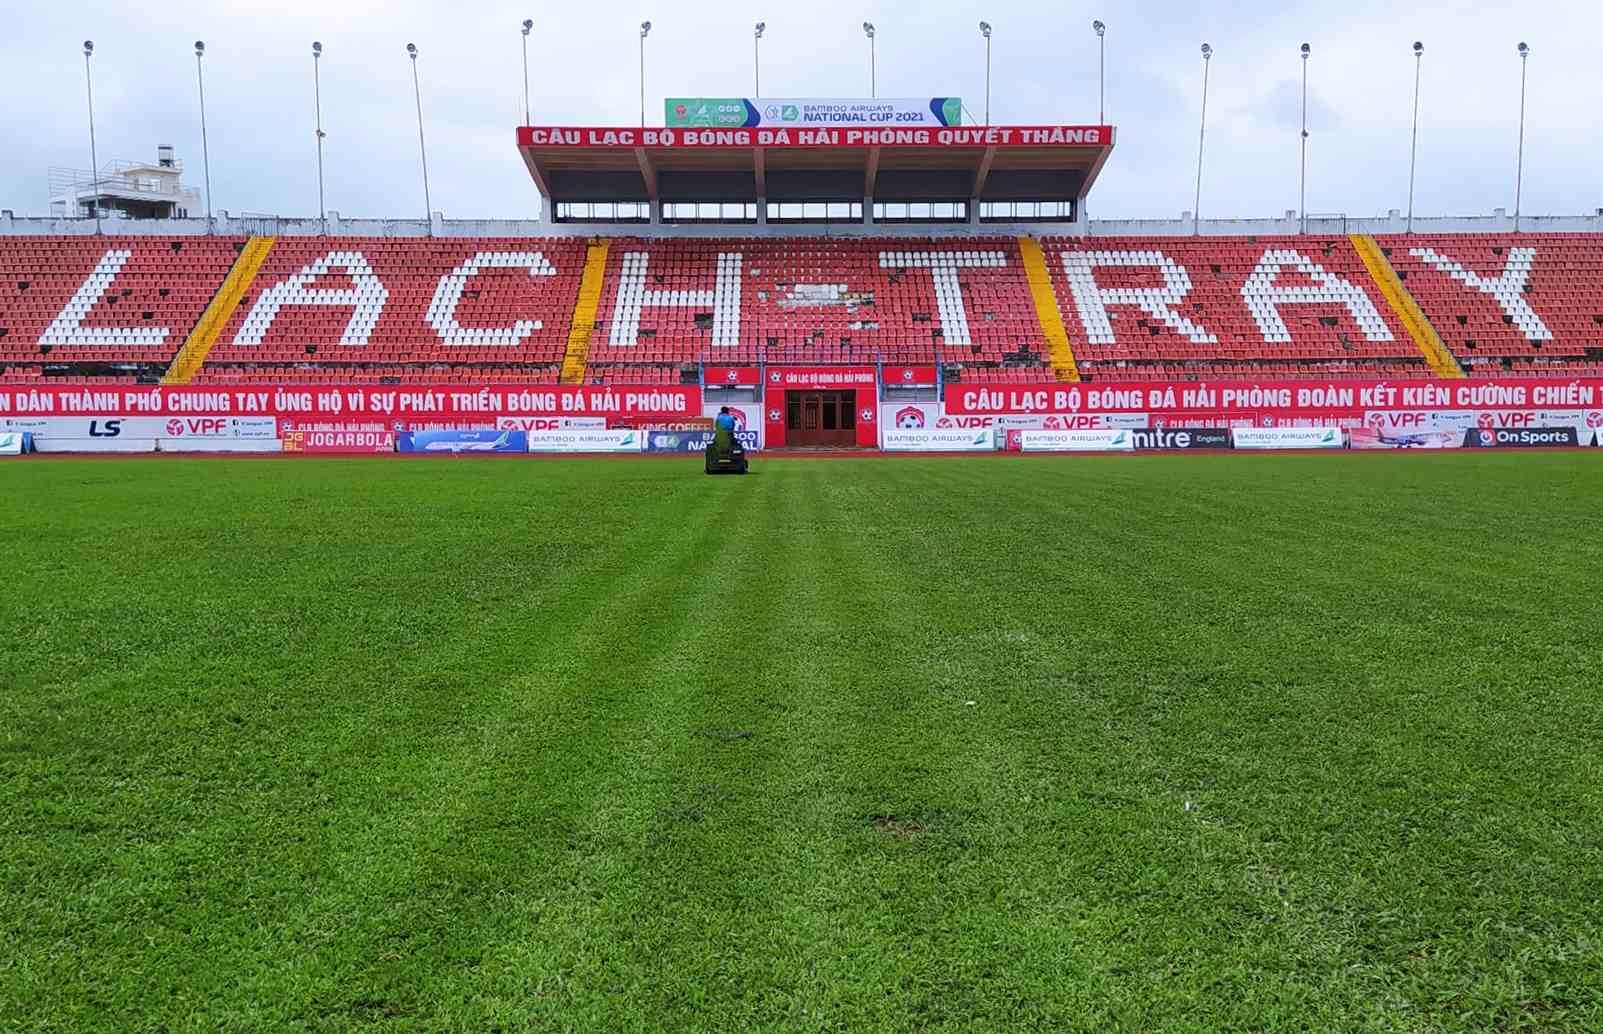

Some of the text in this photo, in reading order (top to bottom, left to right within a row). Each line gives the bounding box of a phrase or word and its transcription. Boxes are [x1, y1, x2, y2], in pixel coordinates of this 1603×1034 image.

[804, 105, 894, 113] BAMBOO AIRWAYS
[803, 112, 924, 122] NATIONAL CUP 2021
[532, 125, 1100, 147] CÂU LẠC BỘ BÓNG ĐÁ HẢI PHÒNG QUYẾT THẮNG
[16, 389, 53, 411] DÂN
[59, 389, 118, 411] THÀNH
[125, 388, 162, 411] PHỐ
[168, 393, 230, 411] CHUNG
[236, 393, 269, 411] TAY
[275, 388, 312, 411] ỦNG
[318, 389, 341, 414] HỘ
[347, 389, 364, 411] VÌ
[371, 391, 396, 414] SỰ
[400, 390, 445, 411] PHÁT
[450, 387, 503, 411] TRIỂN
[508, 390, 556, 411] BÓNG
[561, 390, 586, 411] ĐÁ
[591, 387, 619, 411] HẢI
[626, 389, 686, 411] PHÒNG
[964, 388, 1004, 410] CÂU
[1010, 392, 1047, 413] LẠC
[1055, 388, 1081, 412] BỘ
[1088, 387, 1144, 409] BÓNG
[1149, 386, 1176, 408] ĐÁ
[1183, 383, 1216, 408] HẢI
[1222, 385, 1291, 407] PHÒNG
[1298, 385, 1353, 407] ĐOÀN
[1360, 382, 1397, 406] KẾT
[1403, 384, 1450, 406] KIÊN
[1457, 382, 1527, 405] CƯỜNG
[1533, 380, 1593, 405] CHIẾN
[187, 418, 227, 433] VPF
[521, 419, 559, 430] VPF
[955, 417, 993, 428] VPF
[1063, 416, 1101, 428] VPF
[1388, 413, 1426, 427] VPF
[1498, 412, 1535, 427] VPF
[89, 420, 121, 437] LS
[307, 432, 393, 446] JOGARBOLA
[702, 432, 755, 440] BOO
[1133, 428, 1191, 447] mitre
[688, 440, 757, 450] NAAL
